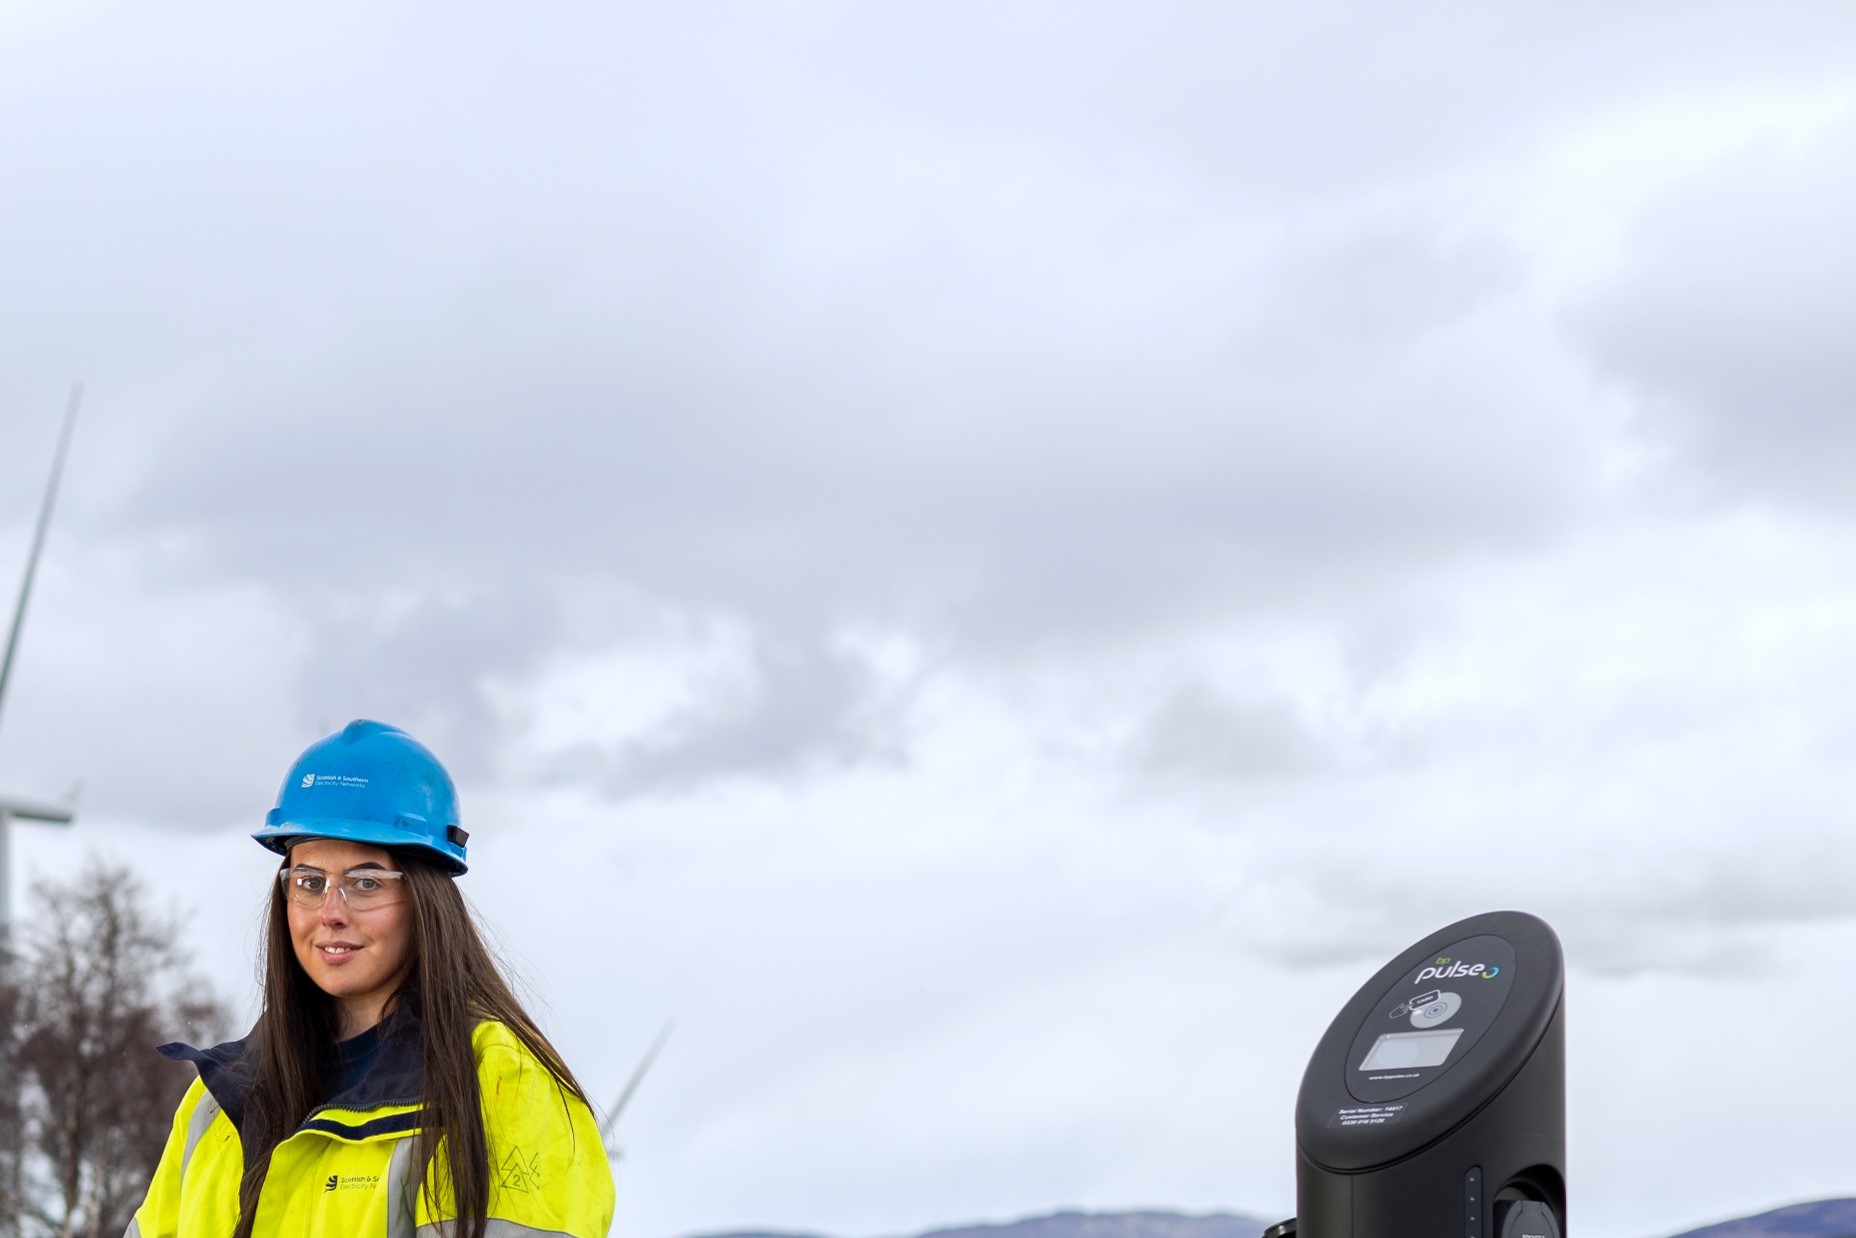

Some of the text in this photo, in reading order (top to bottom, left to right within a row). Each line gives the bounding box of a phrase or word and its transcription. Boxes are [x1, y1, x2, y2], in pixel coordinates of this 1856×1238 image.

[1435, 957, 1451, 965] bp
[1414, 960, 1485, 985] pulse
[341, 1176, 366, 1184] Scottish
[513, 1174, 521, 1188] 2
[340, 1183, 369, 1191] Electricity
